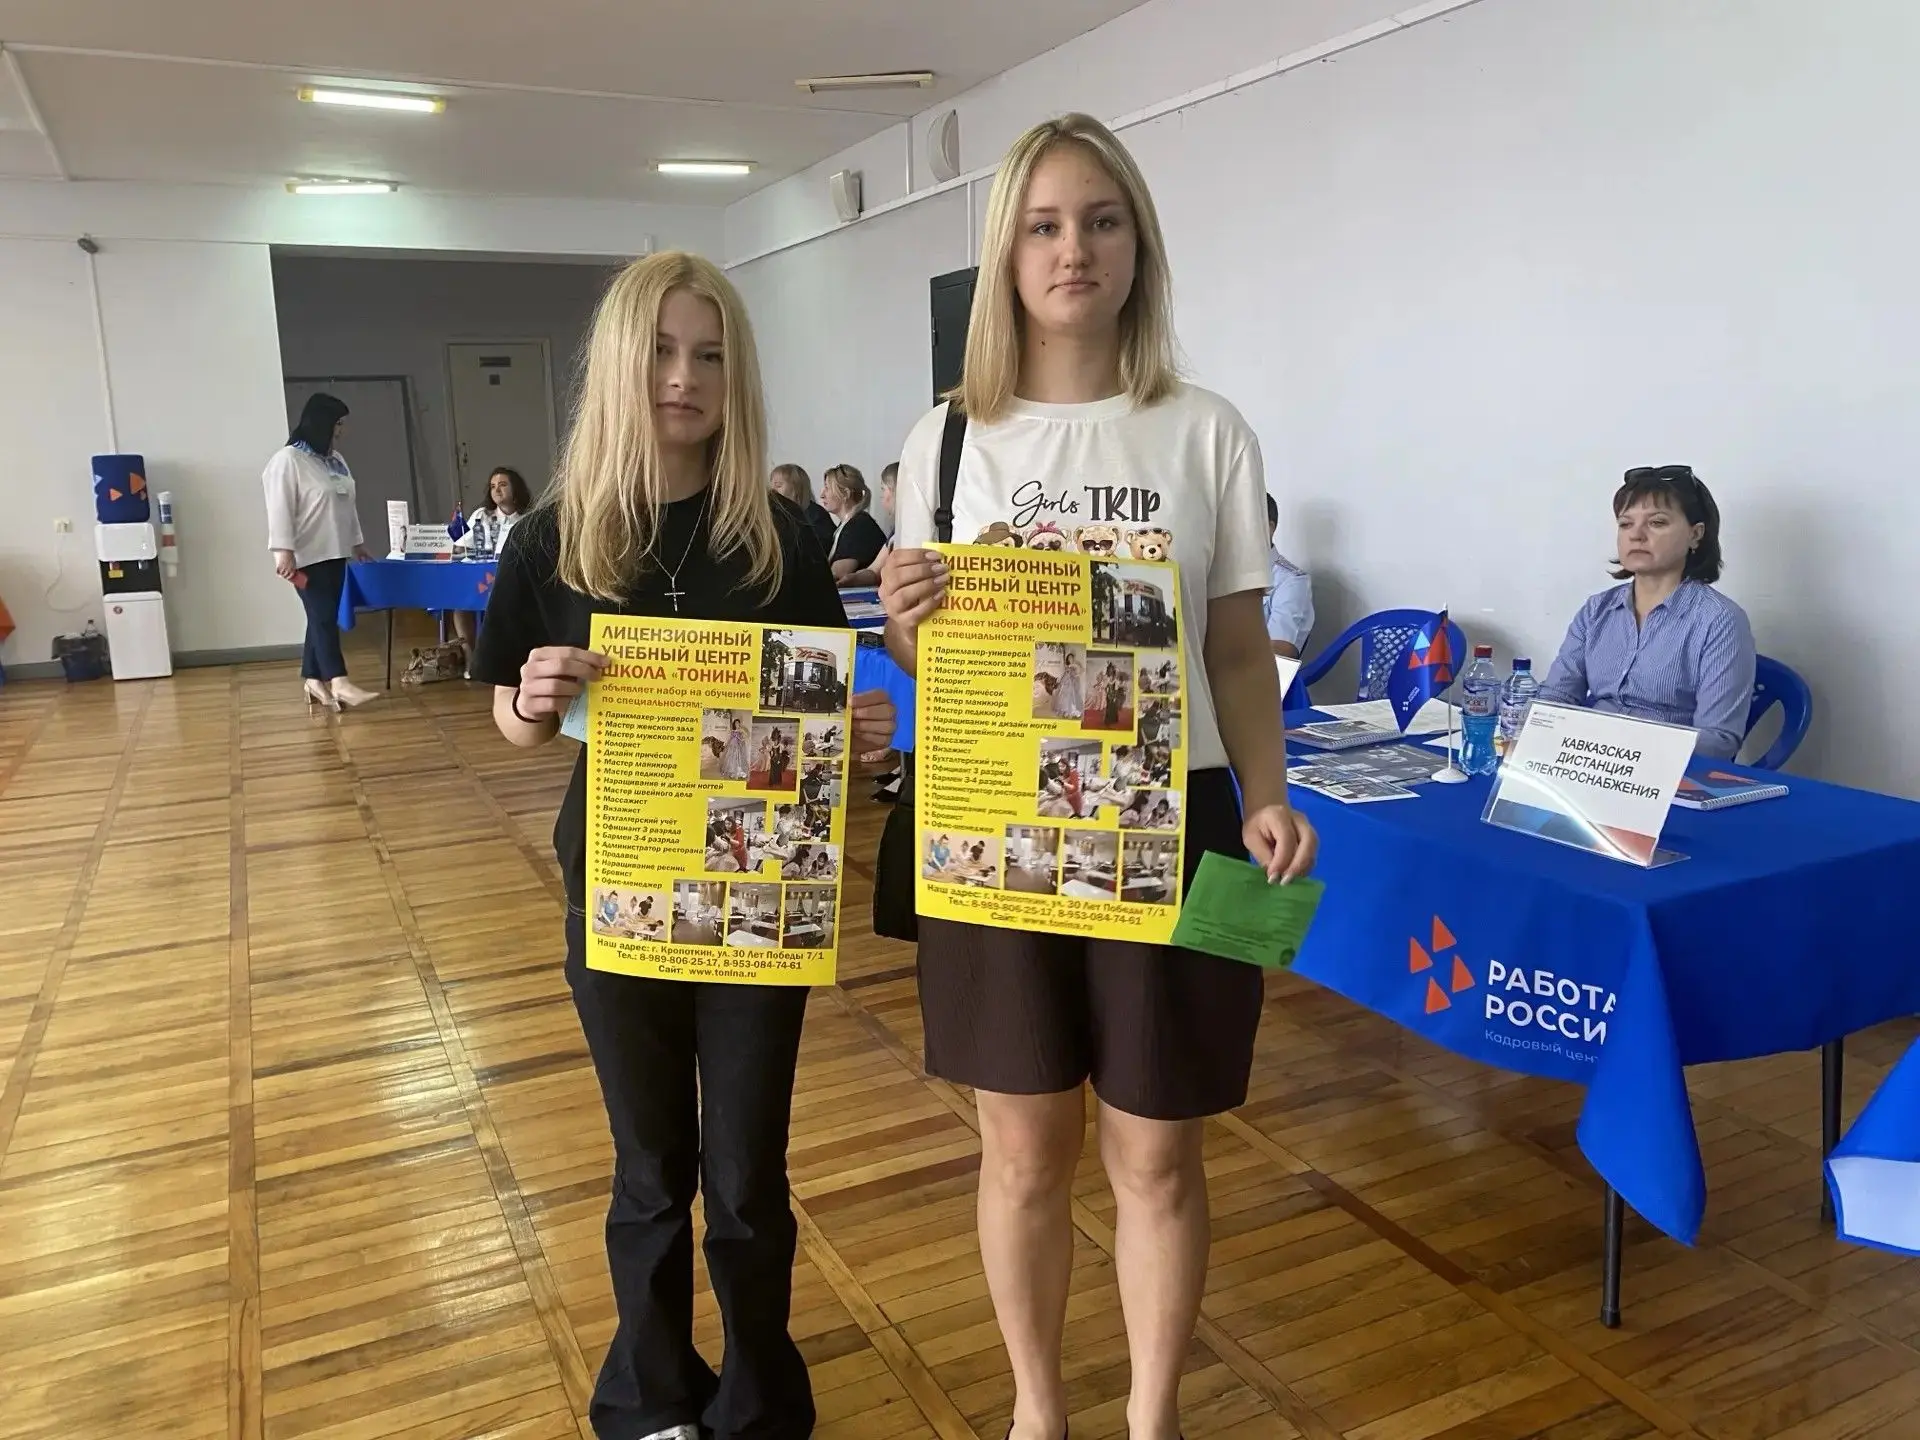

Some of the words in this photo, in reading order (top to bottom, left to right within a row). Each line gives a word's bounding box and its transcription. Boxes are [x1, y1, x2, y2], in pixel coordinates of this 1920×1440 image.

[1011, 480, 1080, 528] Girls
[1084, 486, 1160, 522] TRIP
[944, 556, 1080, 577] ИЦЕНЗИОННЫЙ
[946, 576, 1020, 593] ЧЕБНЫЙ
[1027, 580, 1081, 596] ЦЕНТР
[1004, 599, 1086, 615] «ТОНИНА»
[932, 617, 984, 628] объявляет
[988, 620, 1018, 630] набор
[1037, 622, 1084, 633] обучение
[602, 626, 751, 647] ЛИЦЕНЗИОННЫЙ
[947, 631, 1035, 642] специальностям:
[602, 645, 689, 662] УЧЕБНЫЙ
[695, 650, 751, 665] ЦЕНТР
[935, 646, 1031, 658] Парикмахер-универсал
[935, 657, 965, 666] Мастер
[601, 664, 666, 680] ШКОЛА
[672, 667, 754, 684] «ТОНИНА»
[934, 666, 964, 675] Мастер
[967, 669, 1006, 677] мужского
[934, 677, 971, 685] Колорист
[602, 684, 653, 693] объявляет
[657, 686, 687, 697] набор
[705, 688, 751, 699] обучение
[965, 688, 1004, 696] причёсок
[617, 697, 703, 708] специальностям:
[934, 696, 963, 706] Мастер
[965, 699, 1008, 707] маникюра
[606, 711, 698, 723] Парикмахер-универсал
[933, 707, 962, 715] Мастер
[965, 708, 1006, 717] педикюра
[605, 721, 634, 729] Мастер
[933, 716, 991, 727] Наращивание
[998, 721, 1028, 729] дизайн
[605, 730, 634, 739] Мастер
[933, 726, 963, 735] Мастер
[965, 729, 1004, 737] швейного
[605, 740, 641, 749] Колорист
[932, 735, 978, 744] Массажист
[604, 749, 633, 757] Дизайн
[635, 751, 672, 759] причёсок
[932, 745, 971, 754] Визажист
[1561, 736, 1641, 762] КАВКАЗСКАЯ
[604, 759, 633, 768] Мастер
[635, 761, 677, 770] маникюра
[932, 755, 989, 765] Бухгалтерский
[1555, 751, 1634, 777] ДИСТАНЦИЯ
[604, 768, 632, 777] Мастер
[635, 771, 674, 779] педикюра
[932, 764, 971, 774] Официант
[980, 769, 1013, 777] разряда
[604, 777, 659, 787] Наращивание
[932, 774, 963, 783] Бармен
[1525, 760, 1660, 800] ЭЛЕКТРОСНАБЖЕНИЯ
[603, 786, 632, 795] Мастер
[634, 789, 672, 797] швейного
[931, 784, 992, 795] Администратор
[994, 790, 1036, 798] ресторана
[603, 795, 647, 804] Массажист
[932, 793, 970, 802] Продавец
[603, 805, 641, 813] Визажист
[603, 814, 658, 824] Бухгалтерский
[932, 811, 963, 820] Бровист
[603, 823, 641, 833] Официант
[931, 821, 994, 833] Офис-менеджер
[603, 832, 632, 840] Бармен
[602, 841, 661, 853] Администратор
[602, 850, 639, 860] Продавец
[601, 859, 656, 870] Наращивание
[601, 868, 632, 877] Бровист
[601, 877, 662, 889] Офис-менеджер
[927, 884, 948, 894] Наш
[1068, 900, 1080, 909] 30
[1083, 902, 1100, 910] Лет
[1104, 904, 1143, 915] Победы
[1147, 907, 1167, 916] 7/1
[991, 912, 1018, 922] Сайт:
[597, 938, 616, 946] Наш
[620, 943, 650, 951] адрес:
[661, 946, 714, 956] Кропоткин,
[718, 950, 729, 958] ул.
[733, 950, 745, 958] 30
[747, 950, 764, 959] Лет
[767, 951, 803, 960] Победы
[806, 951, 824, 961] 7/1
[617, 950, 637, 960] Тел.:
[640, 953, 720, 967] 8-989-806-25-17,
[724, 959, 802, 969] 8-953-084-74-61
[659, 964, 683, 974] Сайт:
[689, 968, 756, 978] www.tonina.ru
[1488, 960, 1616, 1014] РАБОТА
[1485, 994, 1607, 1045] РОССИ
[1485, 1030, 1562, 1054] Кадровый
[1566, 1048, 1598, 1064] цен
